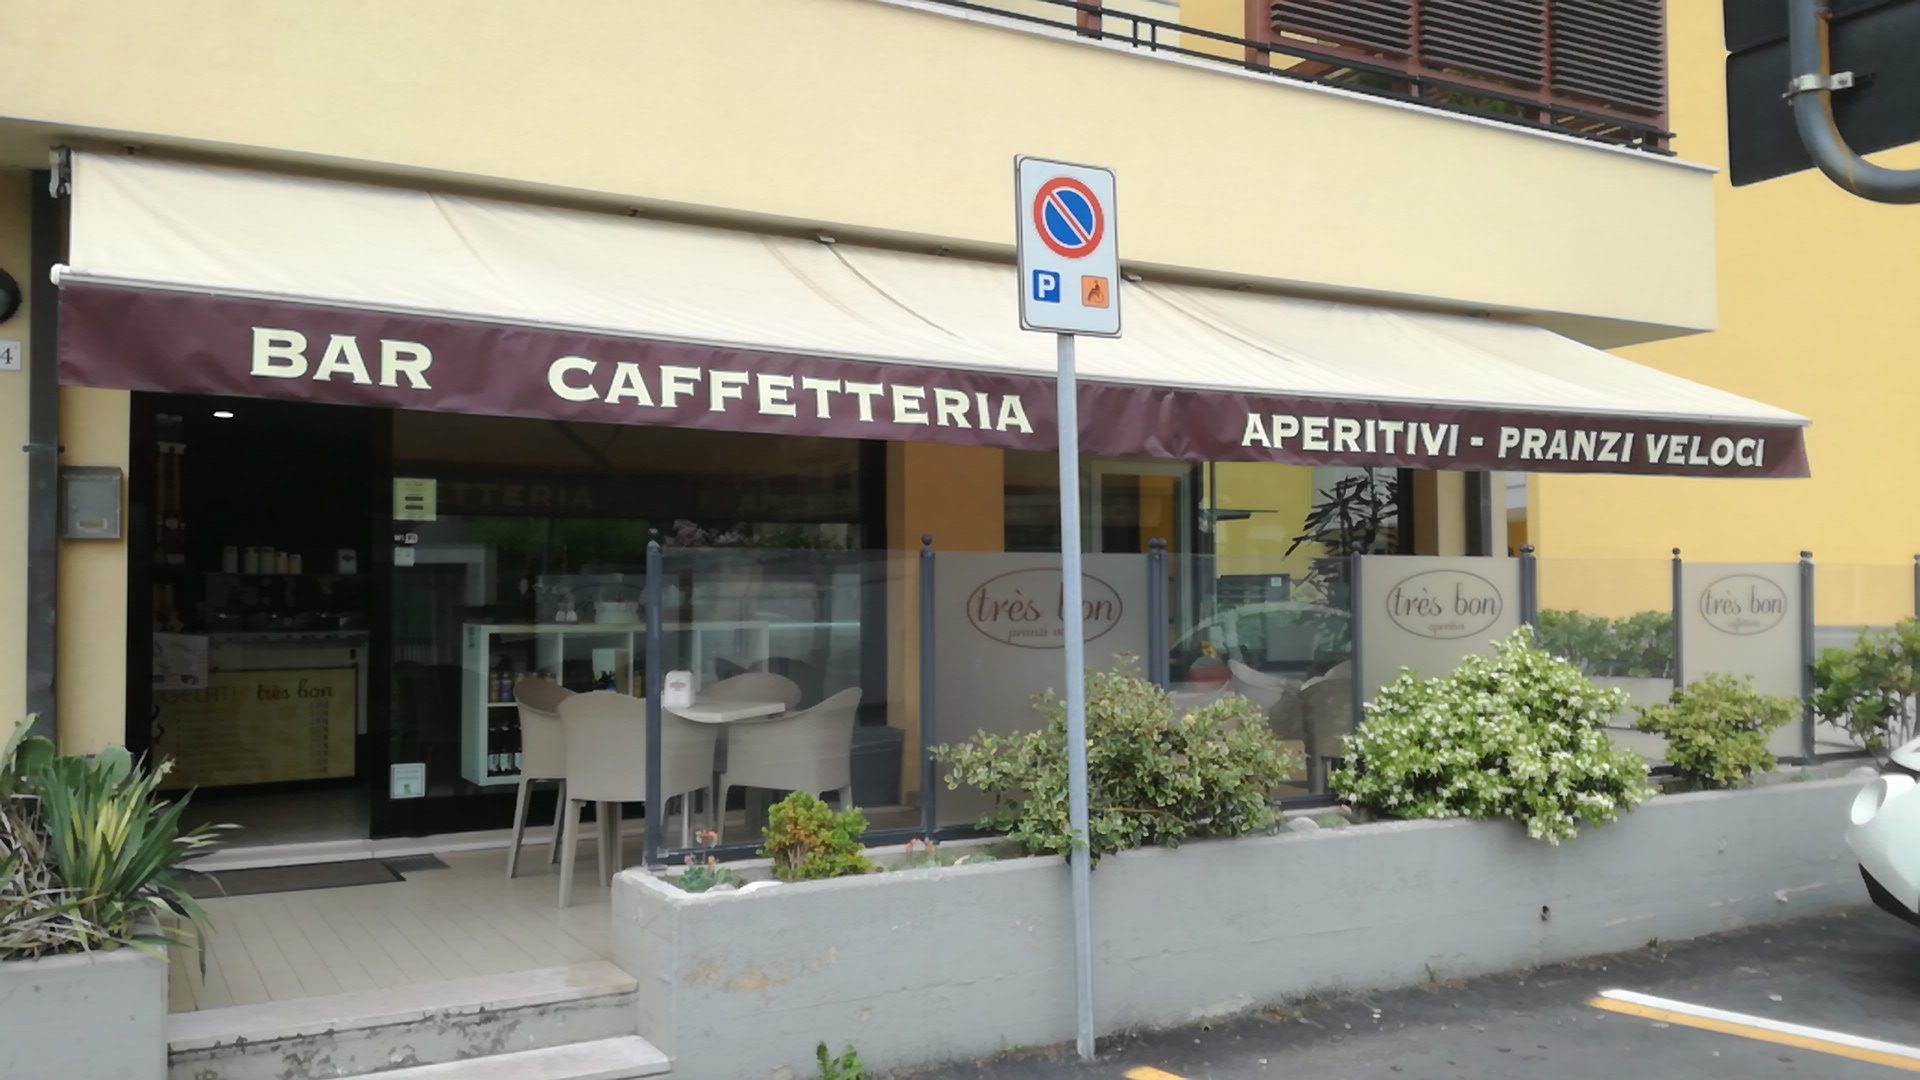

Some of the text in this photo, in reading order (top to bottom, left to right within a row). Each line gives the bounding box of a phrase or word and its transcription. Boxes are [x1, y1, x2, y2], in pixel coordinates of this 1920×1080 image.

[1037, 272, 1056, 299] P
[0, 347, 13, 365] 4
[249, 326, 433, 390] BAR
[547, 355, 1035, 435] CAFFETTERIA
[1240, 412, 1460, 457] APERITIVI
[1497, 425, 1636, 463] PRANZI
[1645, 432, 1766, 468] VELOCI
[976, 586, 1042, 623] très
[1394, 581, 1496, 617] très bon
[1705, 584, 1783, 616] très bon
[256, 683, 290, 701] très
[296, 678, 333, 699] bon
